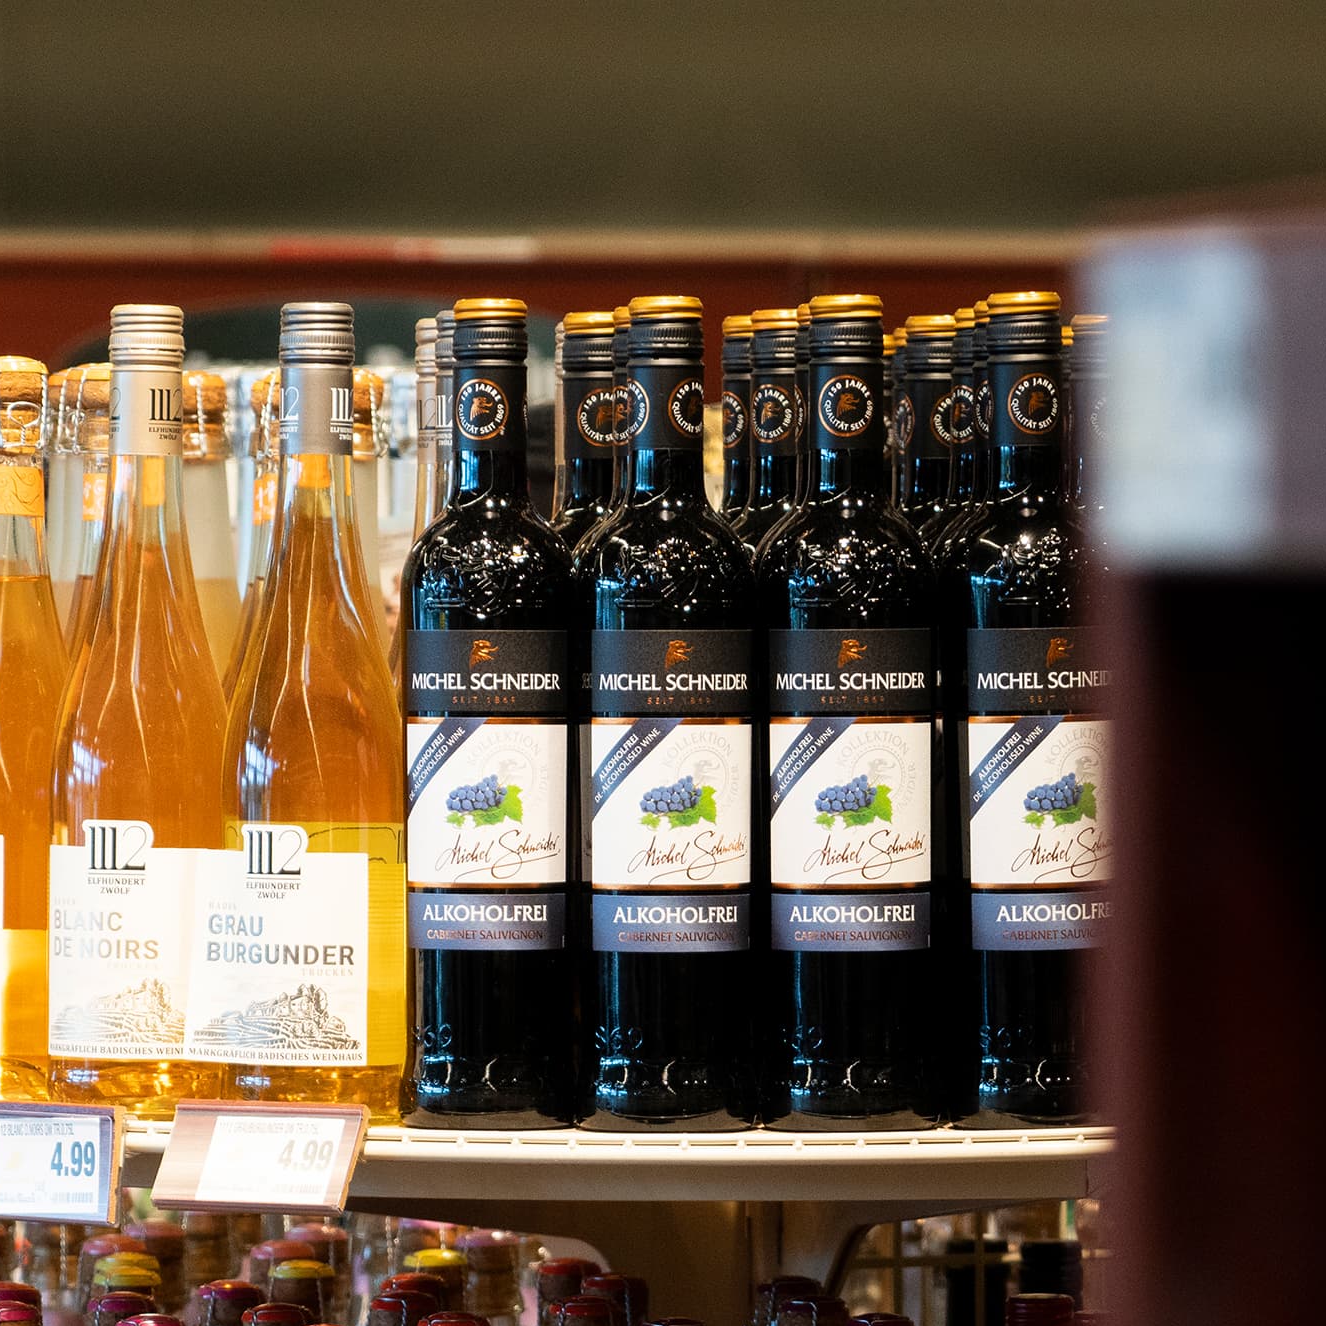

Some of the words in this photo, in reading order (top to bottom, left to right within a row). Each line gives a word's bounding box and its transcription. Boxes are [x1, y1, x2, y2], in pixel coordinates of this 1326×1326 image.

[475, 384, 501, 402] JAHRE
[828, 383, 842, 398] 150
[845, 379, 871, 398] JAHRE
[1016, 381, 1029, 395] 150
[1032, 377, 1056, 395] JAHRE
[764, 389, 789, 407] JAHRE
[672, 402, 695, 432] QUALITÄT
[824, 400, 848, 431] QUALITÄT
[850, 419, 866, 431] SEIT
[865, 401, 874, 419] 1869
[1010, 398, 1037, 429] QUALITÄT
[1038, 416, 1052, 429] SEIT
[480, 422, 495, 434] SEIT
[579, 412, 603, 441] QUALITÄT
[768, 426, 784, 438] SEIT
[412, 673, 466, 690] MICHEL
[470, 672, 560, 690] SCHNEIDER
[599, 674, 661, 691] MICHEL
[665, 673, 748, 691] SCHNEIDER
[776, 673, 835, 690] MICHEL
[839, 672, 925, 690] SCHNEIDER
[977, 672, 1043, 689] MICHEL
[446, 726, 466, 747] WINE
[411, 732, 446, 780] ALKOHOLFREI
[598, 733, 640, 782] ALKOHOLFREI
[771, 745, 818, 804] DE-ALCOHOLISED
[815, 726, 835, 746] WINE
[776, 732, 813, 781] ALKOHOLFREI
[972, 743, 1026, 803] DE-ALCOHOLISED
[1022, 724, 1044, 746] WINE
[977, 731, 1023, 781] ALKOHOLFREI
[594, 745, 643, 804] DE-ALCOHOLISED
[640, 727, 661, 749] WINE
[88, 877, 145, 885] ELFHUNDERT
[246, 881, 300, 890] ELFHUNDERT
[100, 886, 130, 895] ZWÖLF
[257, 890, 285, 899] ZWÖLF
[54, 909, 123, 931] BLANC
[423, 904, 547, 922] ALKOHOLFREI
[613, 906, 737, 924] ALKOHOLFREI
[789, 905, 915, 923] ALKOHOLFREI
[996, 902, 1112, 922] ALKOHOLFRE
[208, 914, 263, 936] GRAU
[427, 929, 477, 940] CABERNET
[479, 929, 543, 940] SAUVIGNON
[849, 930, 912, 941] SAUVIGNON
[54, 938, 72, 957] DE
[79, 939, 160, 960] NOIRS
[207, 942, 354, 965] BURGUNDER
[100, 1045, 153, 1055] BADISCHES
[189, 1047, 256, 1059] MARKGRÄFLICH
[258, 1051, 309, 1061] BADISCHES
[312, 1052, 363, 1061] WEINHAUS
[51, 1141, 95, 1176] 4.99
[278, 1139, 334, 1170] 4.99
